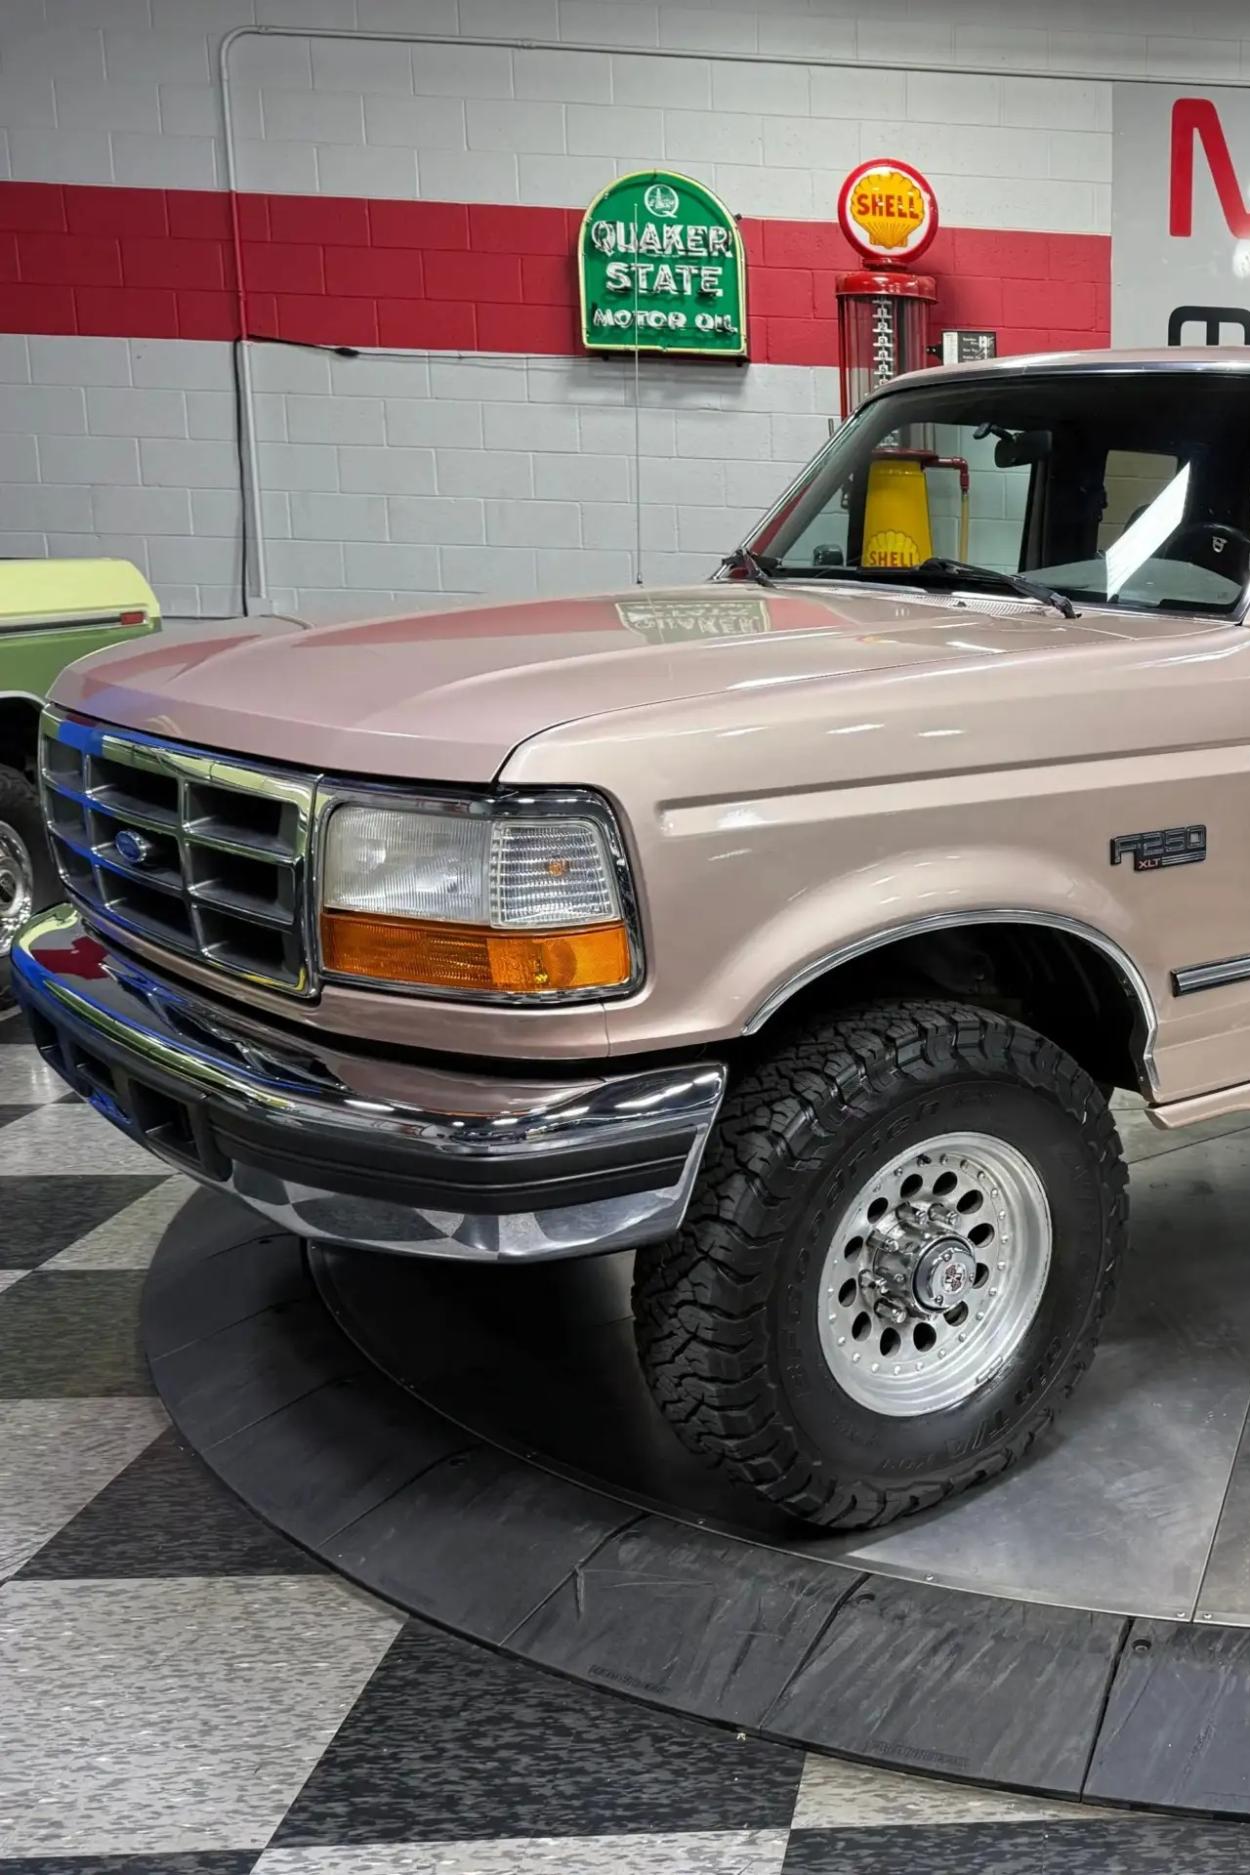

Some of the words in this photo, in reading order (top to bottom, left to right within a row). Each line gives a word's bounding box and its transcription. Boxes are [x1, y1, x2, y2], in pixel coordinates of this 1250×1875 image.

[856, 192, 920, 220] SHELL
[591, 220, 733, 257] QUAKER
[605, 262, 724, 297] STATE
[593, 307, 688, 330] MOTOR
[694, 311, 738, 333] OIL
[1138, 859, 1160, 869] XLT
